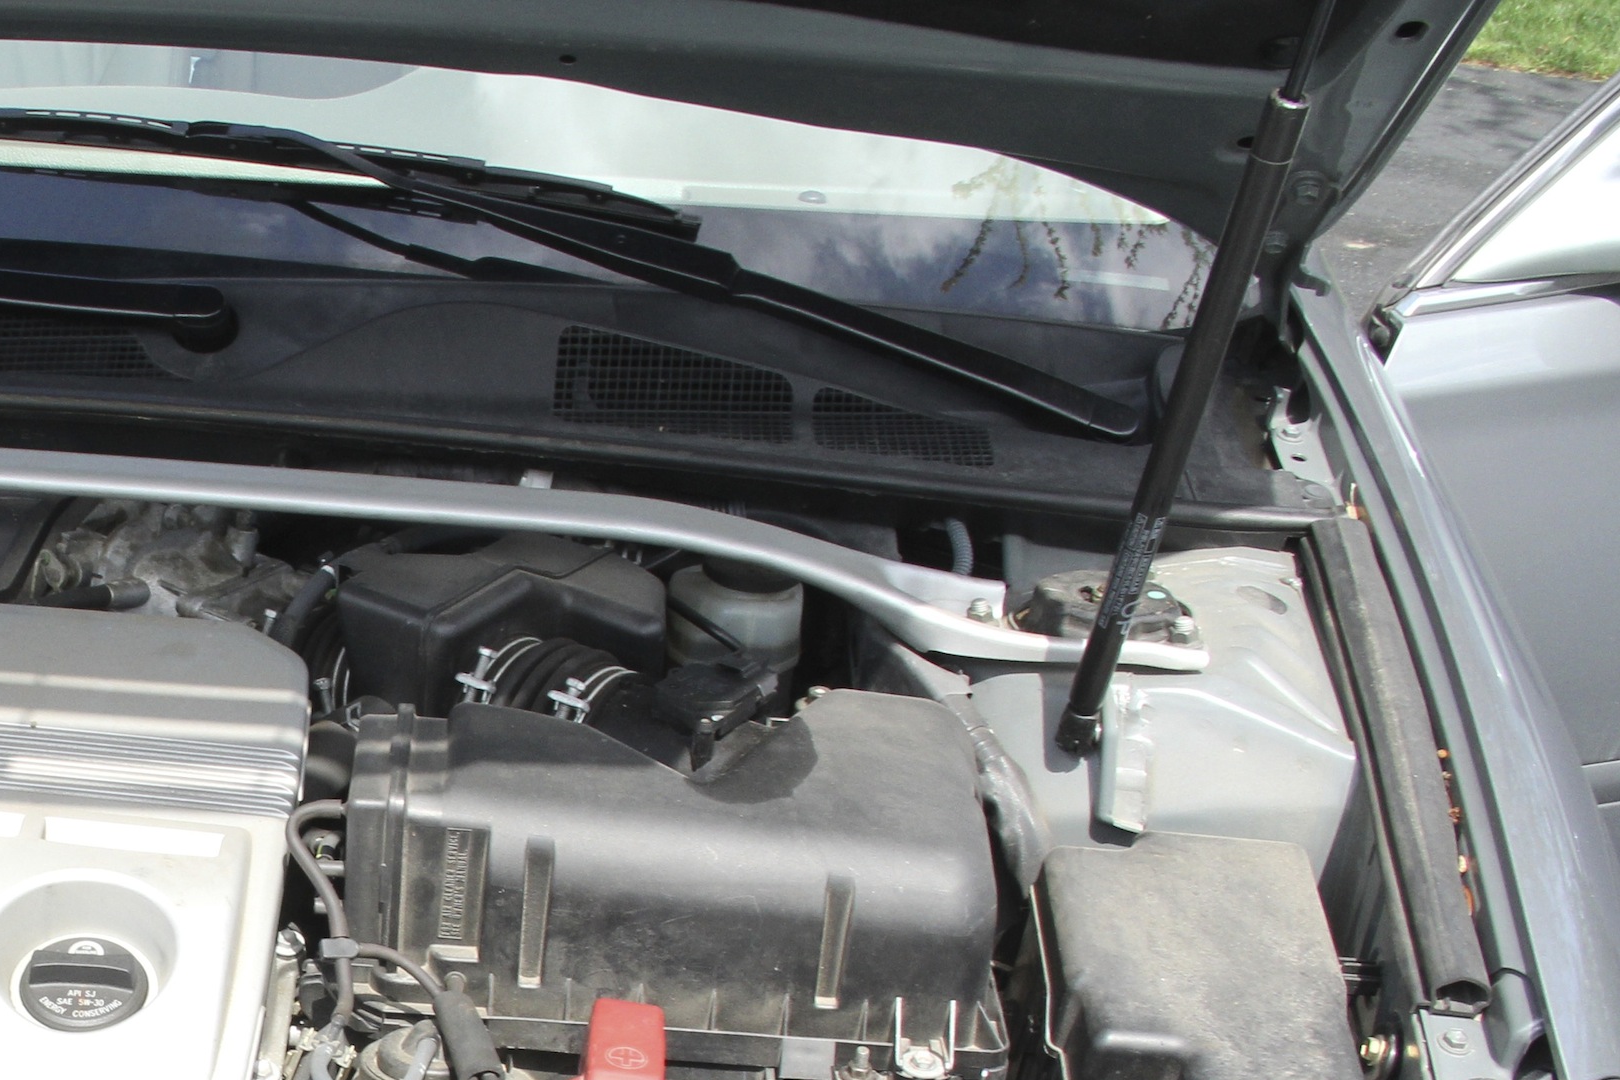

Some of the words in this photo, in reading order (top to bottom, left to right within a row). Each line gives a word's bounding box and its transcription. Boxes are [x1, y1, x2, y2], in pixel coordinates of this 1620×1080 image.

[67, 989, 82, 997] API
[84, 990, 97, 998] SJ
[39, 996, 68, 1015] ENERGY
[72, 1000, 122, 1018] CONSERVING
[56, 997, 73, 1005] SAE
[77, 998, 105, 1007] 5W-30
